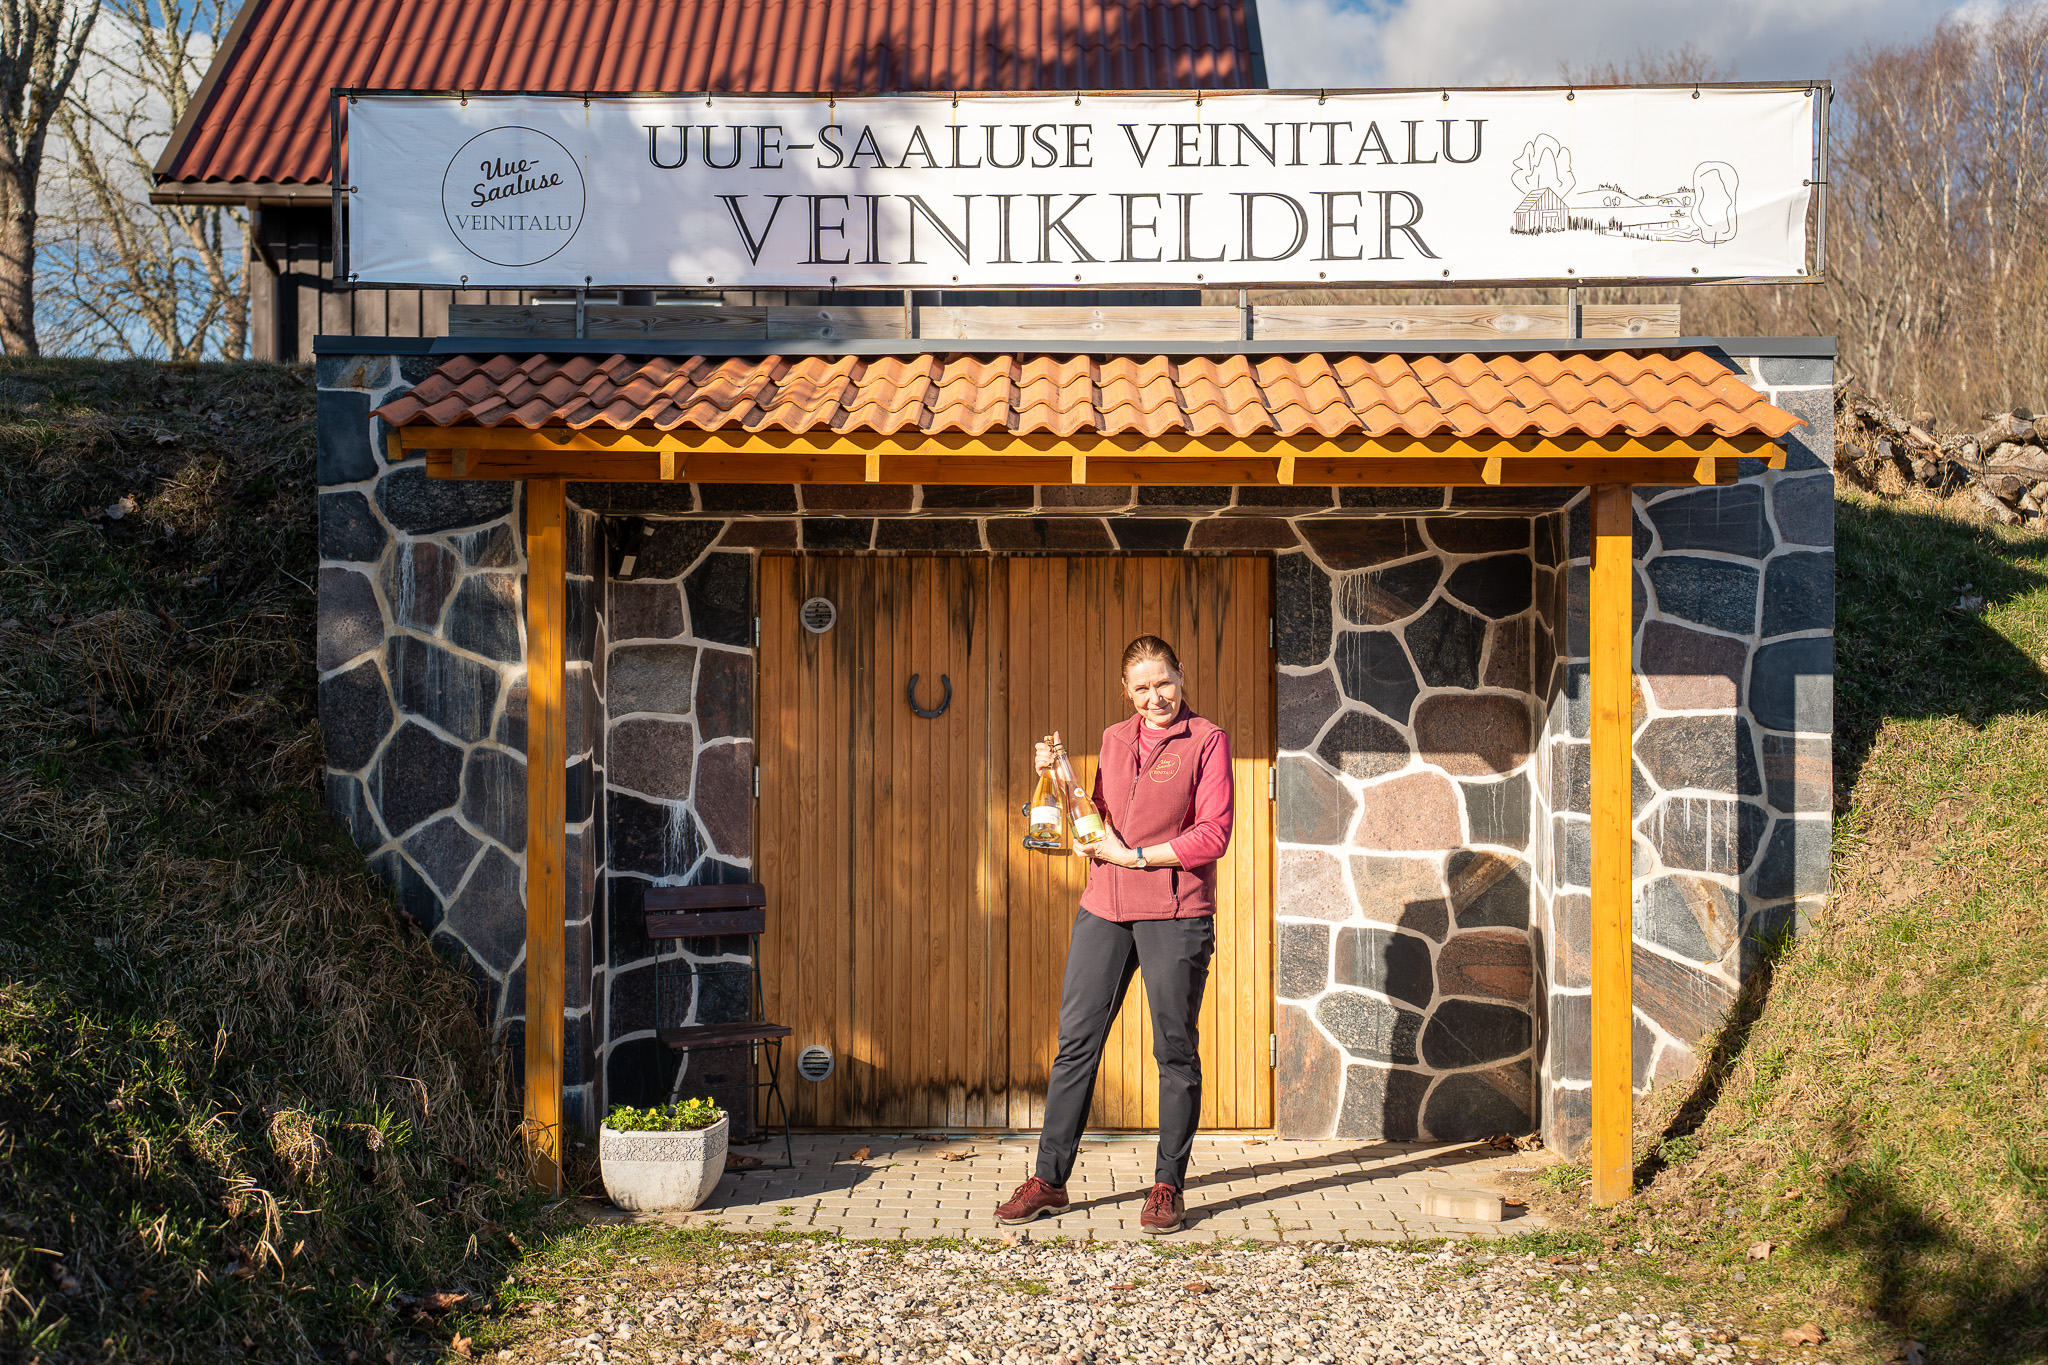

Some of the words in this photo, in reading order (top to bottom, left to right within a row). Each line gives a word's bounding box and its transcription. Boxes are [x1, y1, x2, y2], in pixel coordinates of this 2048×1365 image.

[642, 123, 1093, 170] UUE-SAALUSE
[1117, 119, 1489, 168] VEINITALU
[480, 157, 540, 180] Uue-
[470, 173, 564, 208] Saaluse
[454, 214, 572, 231] VEINITALU
[714, 190, 1443, 267] VEINIKELDER
